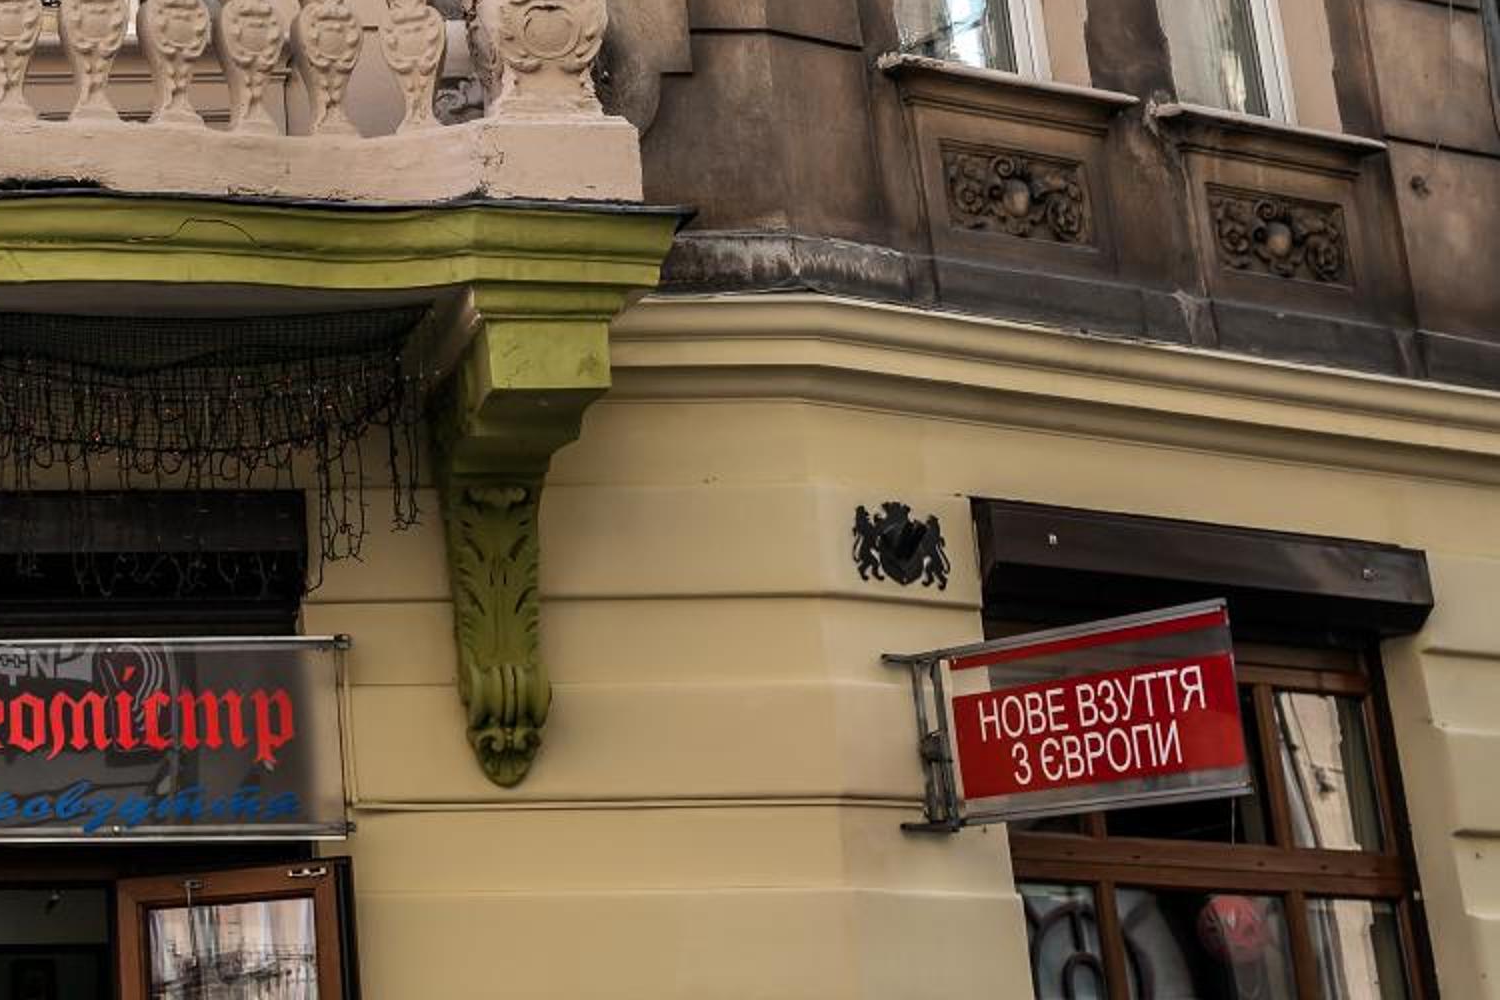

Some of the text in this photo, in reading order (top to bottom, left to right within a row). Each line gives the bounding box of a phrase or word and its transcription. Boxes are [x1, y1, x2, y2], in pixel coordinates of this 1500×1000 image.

[978, 664, 1207, 741] НОВЕ ВЗУТТЯ
[1011, 719, 1184, 786] З ЄВРОПИ
